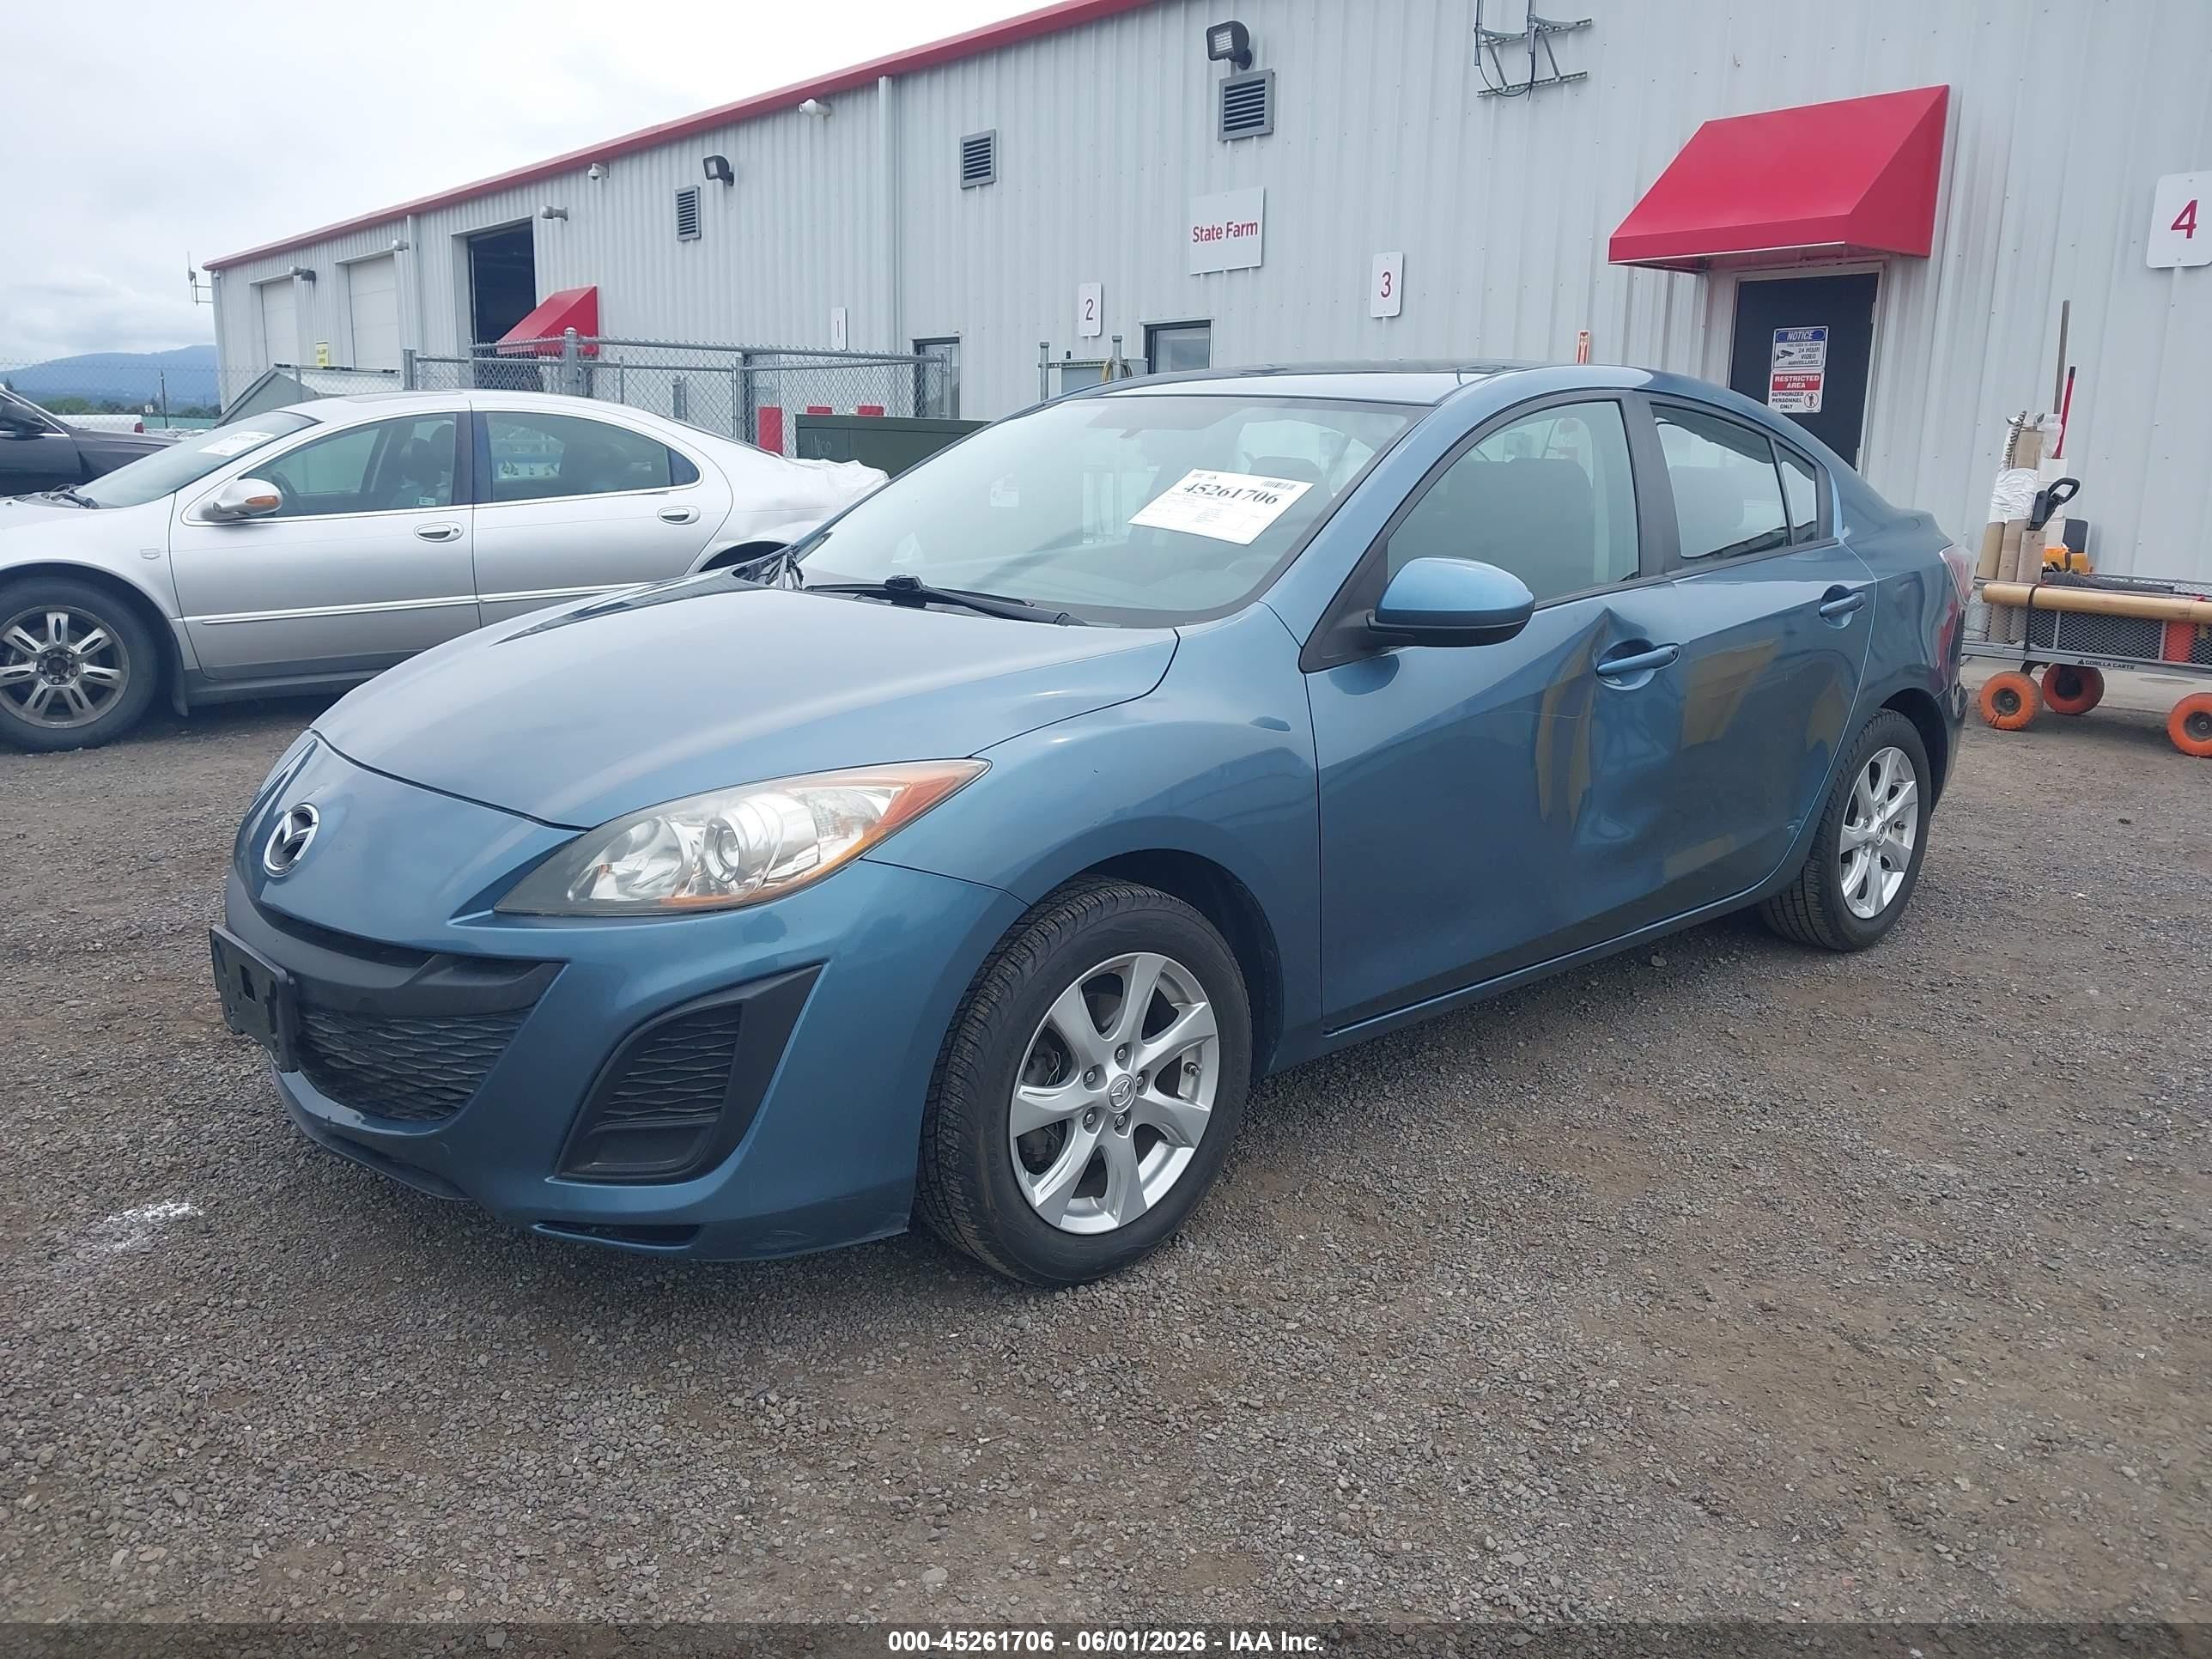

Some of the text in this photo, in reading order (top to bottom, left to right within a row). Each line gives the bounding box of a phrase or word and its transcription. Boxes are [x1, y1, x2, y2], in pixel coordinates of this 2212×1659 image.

[2170, 198, 2198, 240] 4
[1192, 219, 1258, 243] State Farm
[1380, 271, 1392, 299] 3
[1085, 298, 1094, 321] 2
[1787, 331, 1814, 341] NOTICE
[1774, 374, 1820, 383] RESTRICTED
[1183, 483, 1283, 505] 45261706
